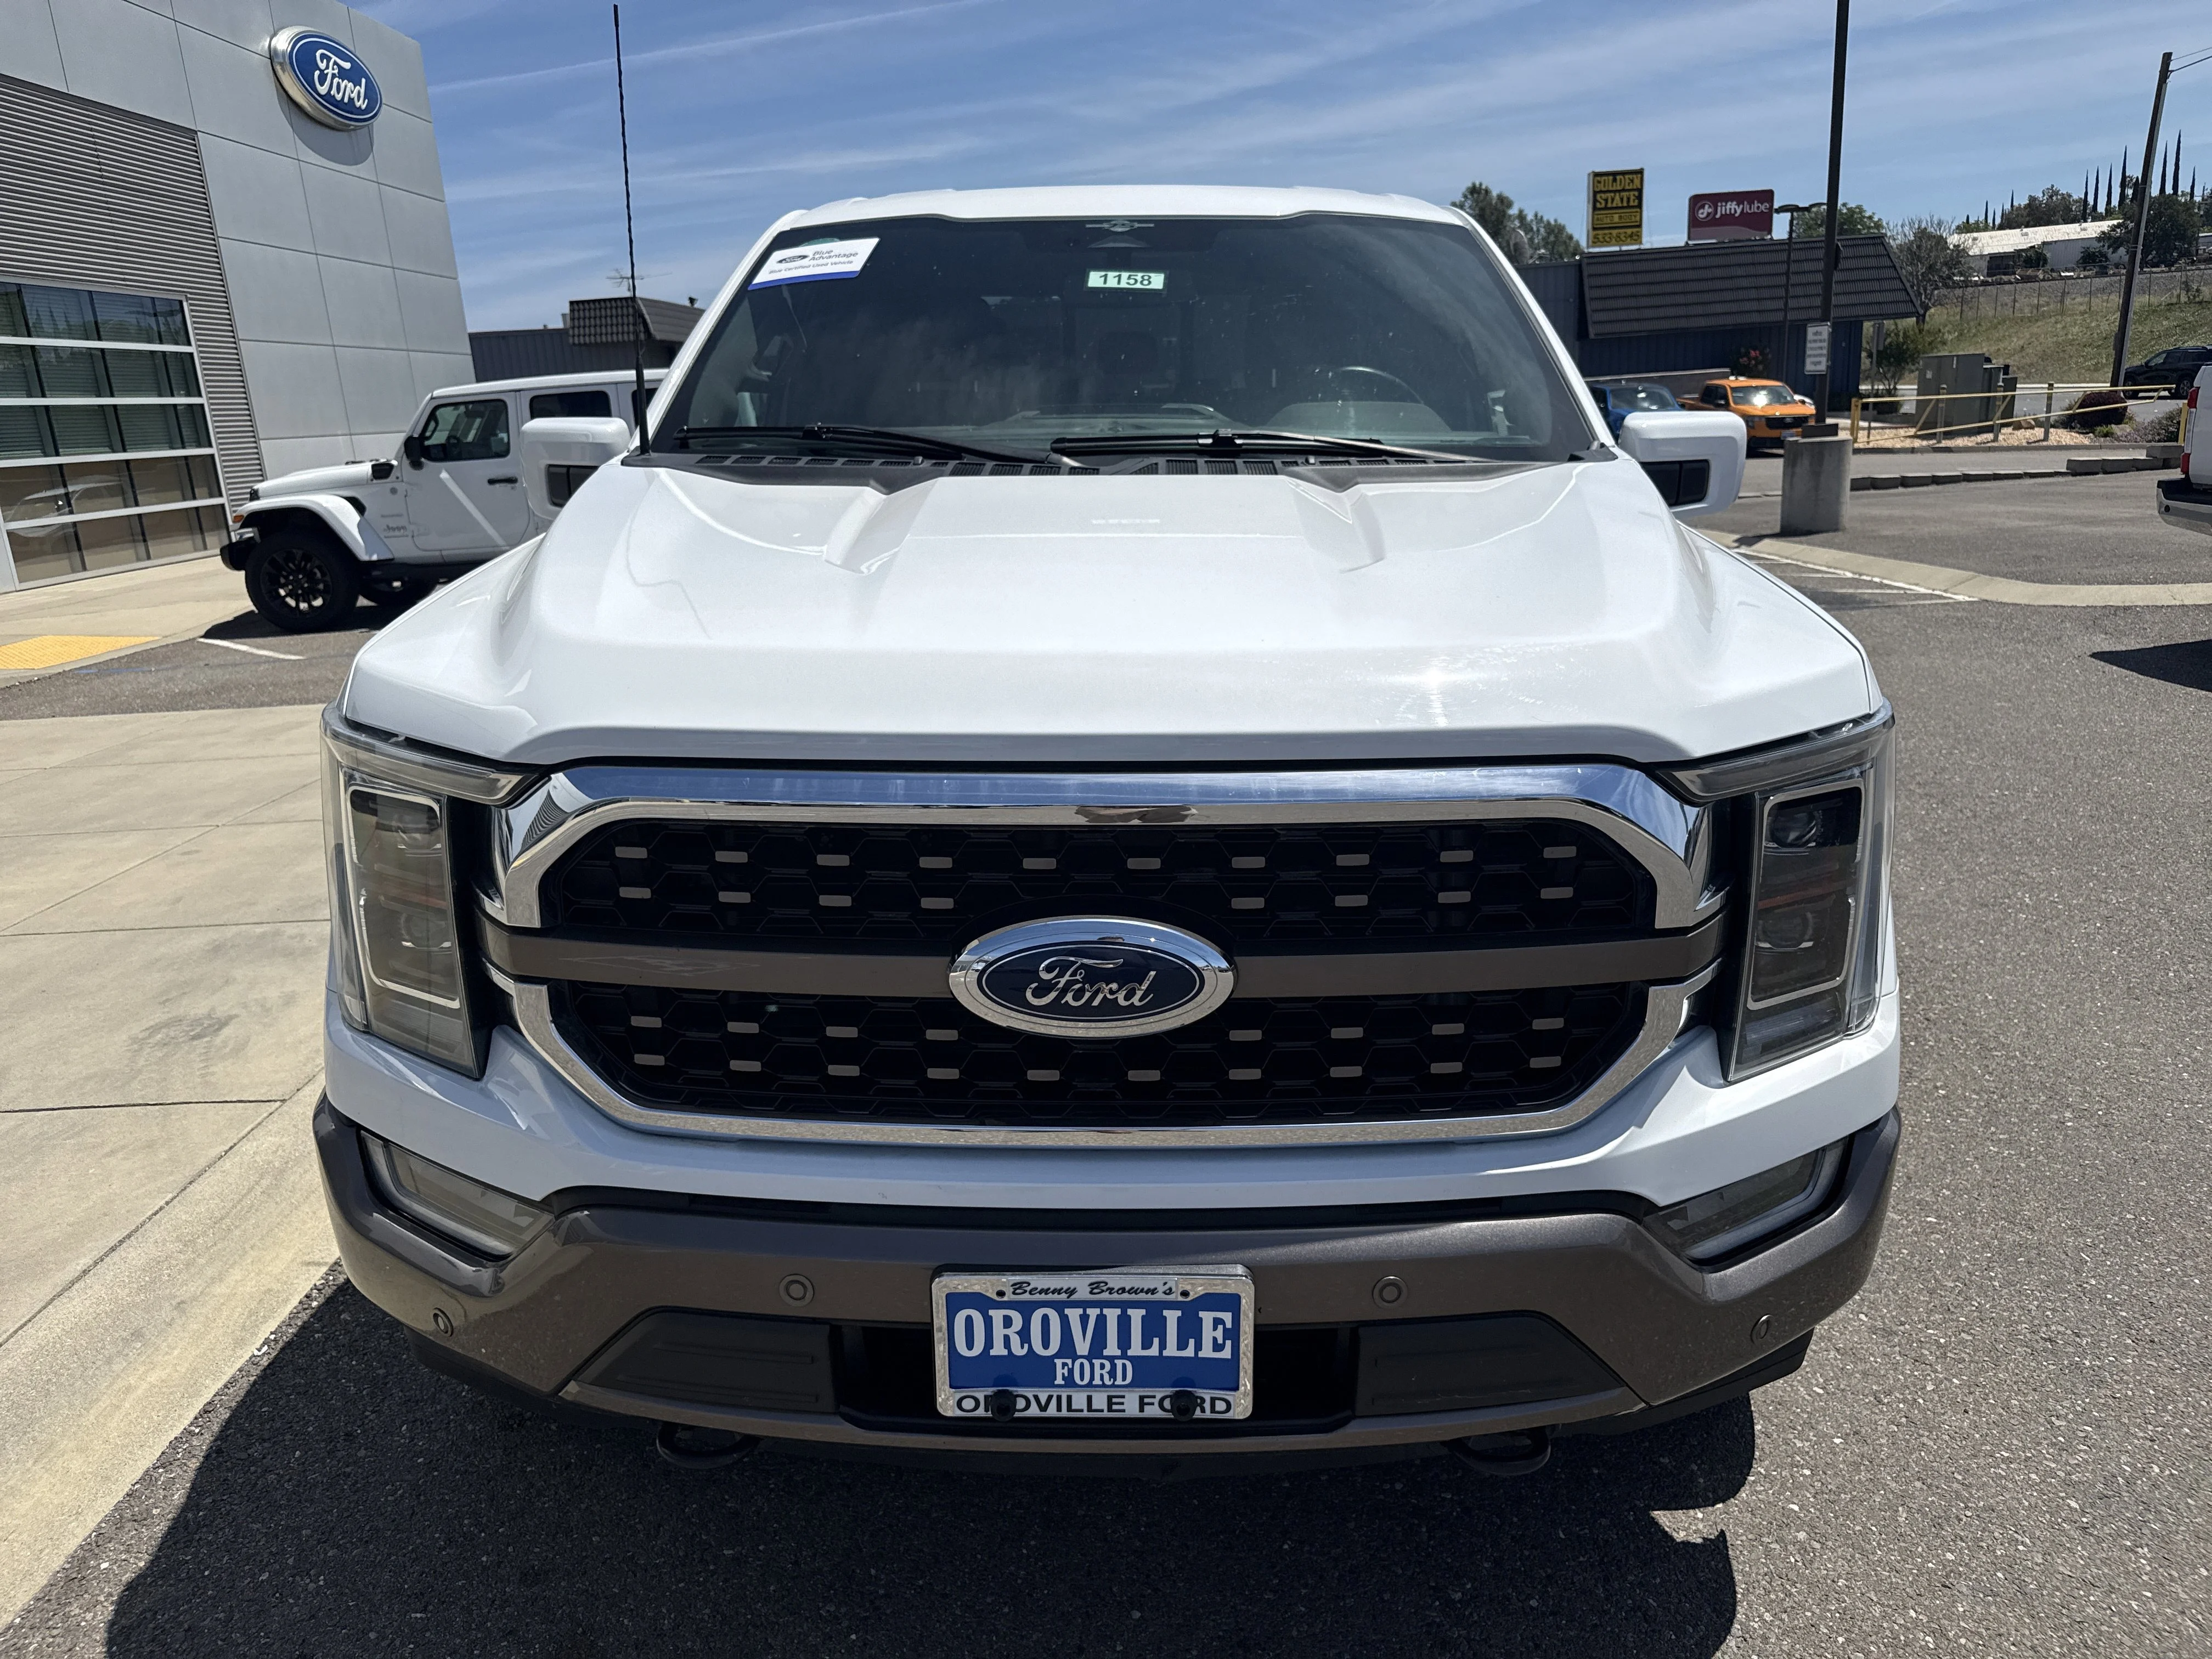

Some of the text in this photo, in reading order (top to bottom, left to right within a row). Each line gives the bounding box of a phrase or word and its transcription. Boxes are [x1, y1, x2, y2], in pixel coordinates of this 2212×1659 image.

[314, 49, 368, 110] Ford
[1594, 174, 1641, 191] GOLDEN
[1596, 191, 1639, 208] STATE
[1716, 200, 1769, 218] jiffy lube
[809, 252, 859, 262] Advantage
[1099, 273, 1152, 286] 1158
[1026, 956, 1156, 1006] Ford
[1011, 1280, 1175, 1299] Benny Brown's
[953, 1307, 1233, 1359] OROVILLE
[1054, 1358, 1133, 1385] FORD
